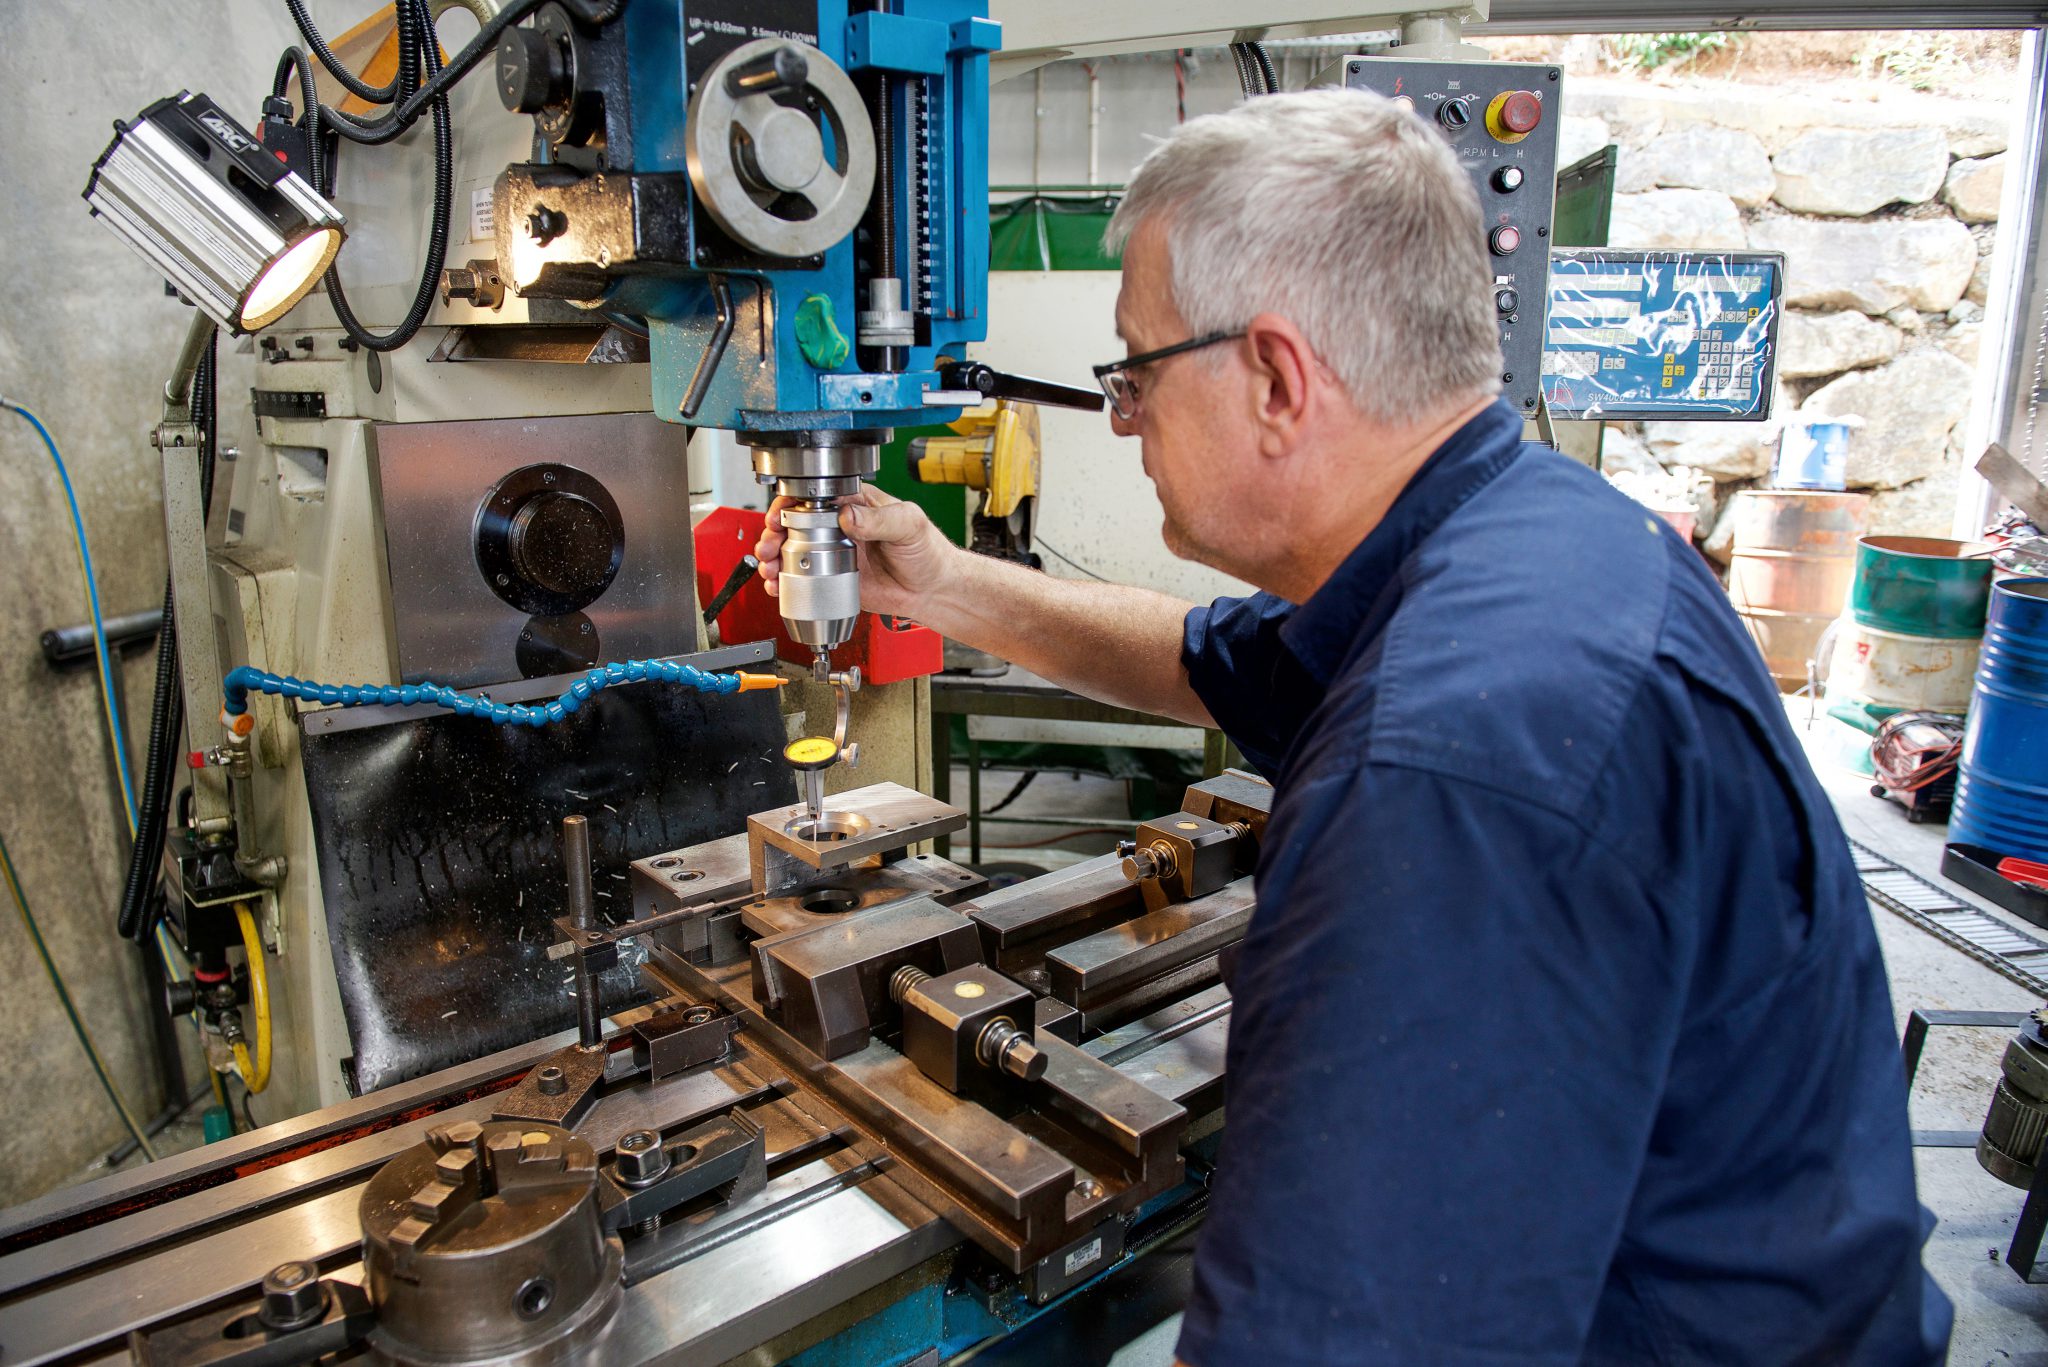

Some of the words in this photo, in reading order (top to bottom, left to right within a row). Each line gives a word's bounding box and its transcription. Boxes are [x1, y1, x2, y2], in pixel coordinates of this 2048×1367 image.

[689, 17, 701, 29] UP
[791, 32, 818, 45] DOWN
[200, 117, 249, 149] ARC
[1492, 148, 1499, 157] L
[1516, 149, 1524, 158] H
[1508, 273, 1515, 282] H
[1504, 332, 1511, 341] H
[291, 394, 298, 402] 25
[303, 394, 311, 402] 30
[1587, 393, 1625, 402] SW4000
